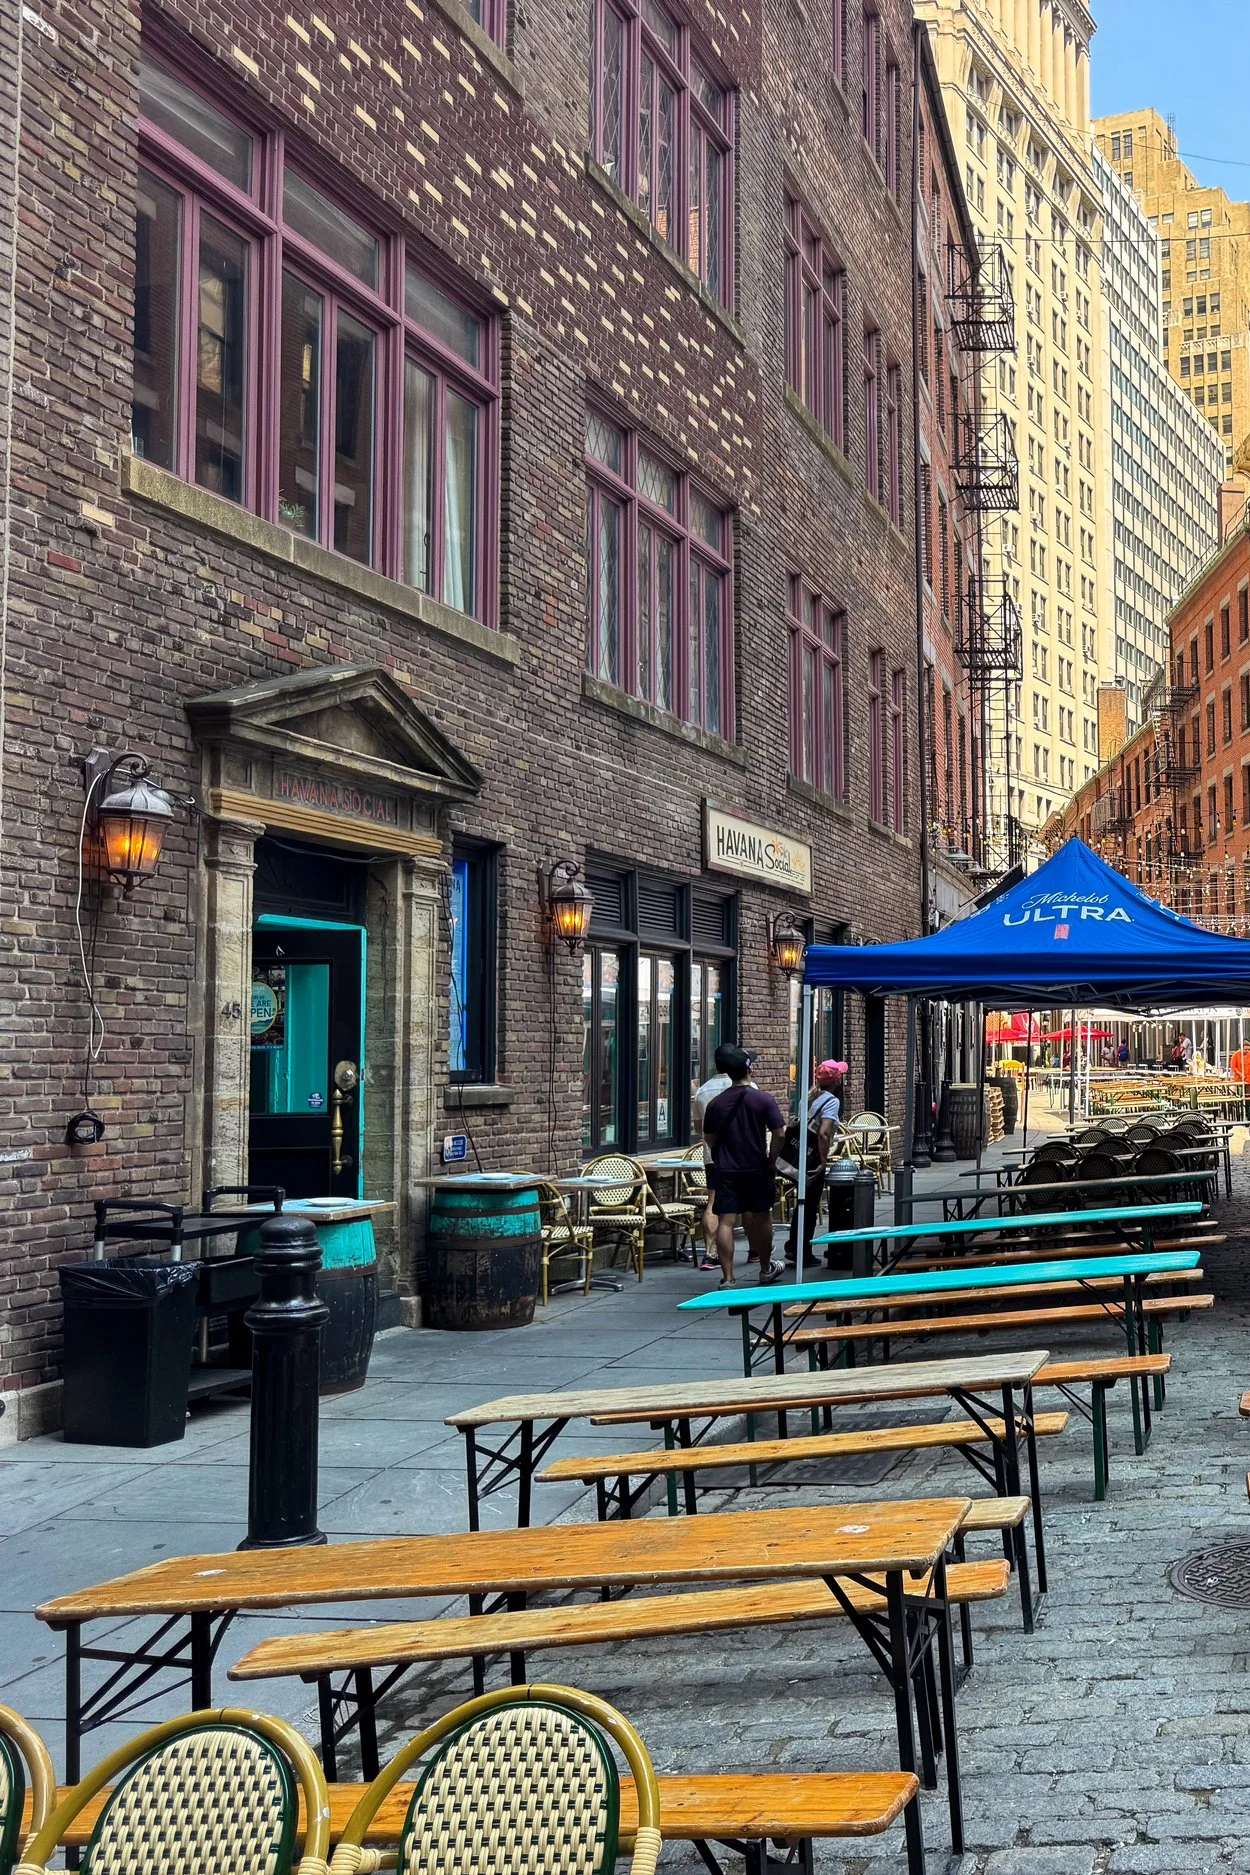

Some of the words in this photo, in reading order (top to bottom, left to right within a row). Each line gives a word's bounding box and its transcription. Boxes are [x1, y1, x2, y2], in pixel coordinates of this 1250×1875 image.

[281, 775, 339, 809] HAVANA
[343, 789, 391, 820] SOCIAL
[716, 824, 764, 869] HAVANA
[764, 843, 792, 874] Social
[1021, 891, 1109, 909] Michelob
[1003, 905, 1132, 927] ULTRA
[221, 1001, 241, 1019] 45
[251, 1008, 272, 1018] PEN
[256, 1000, 271, 1008] ARE
